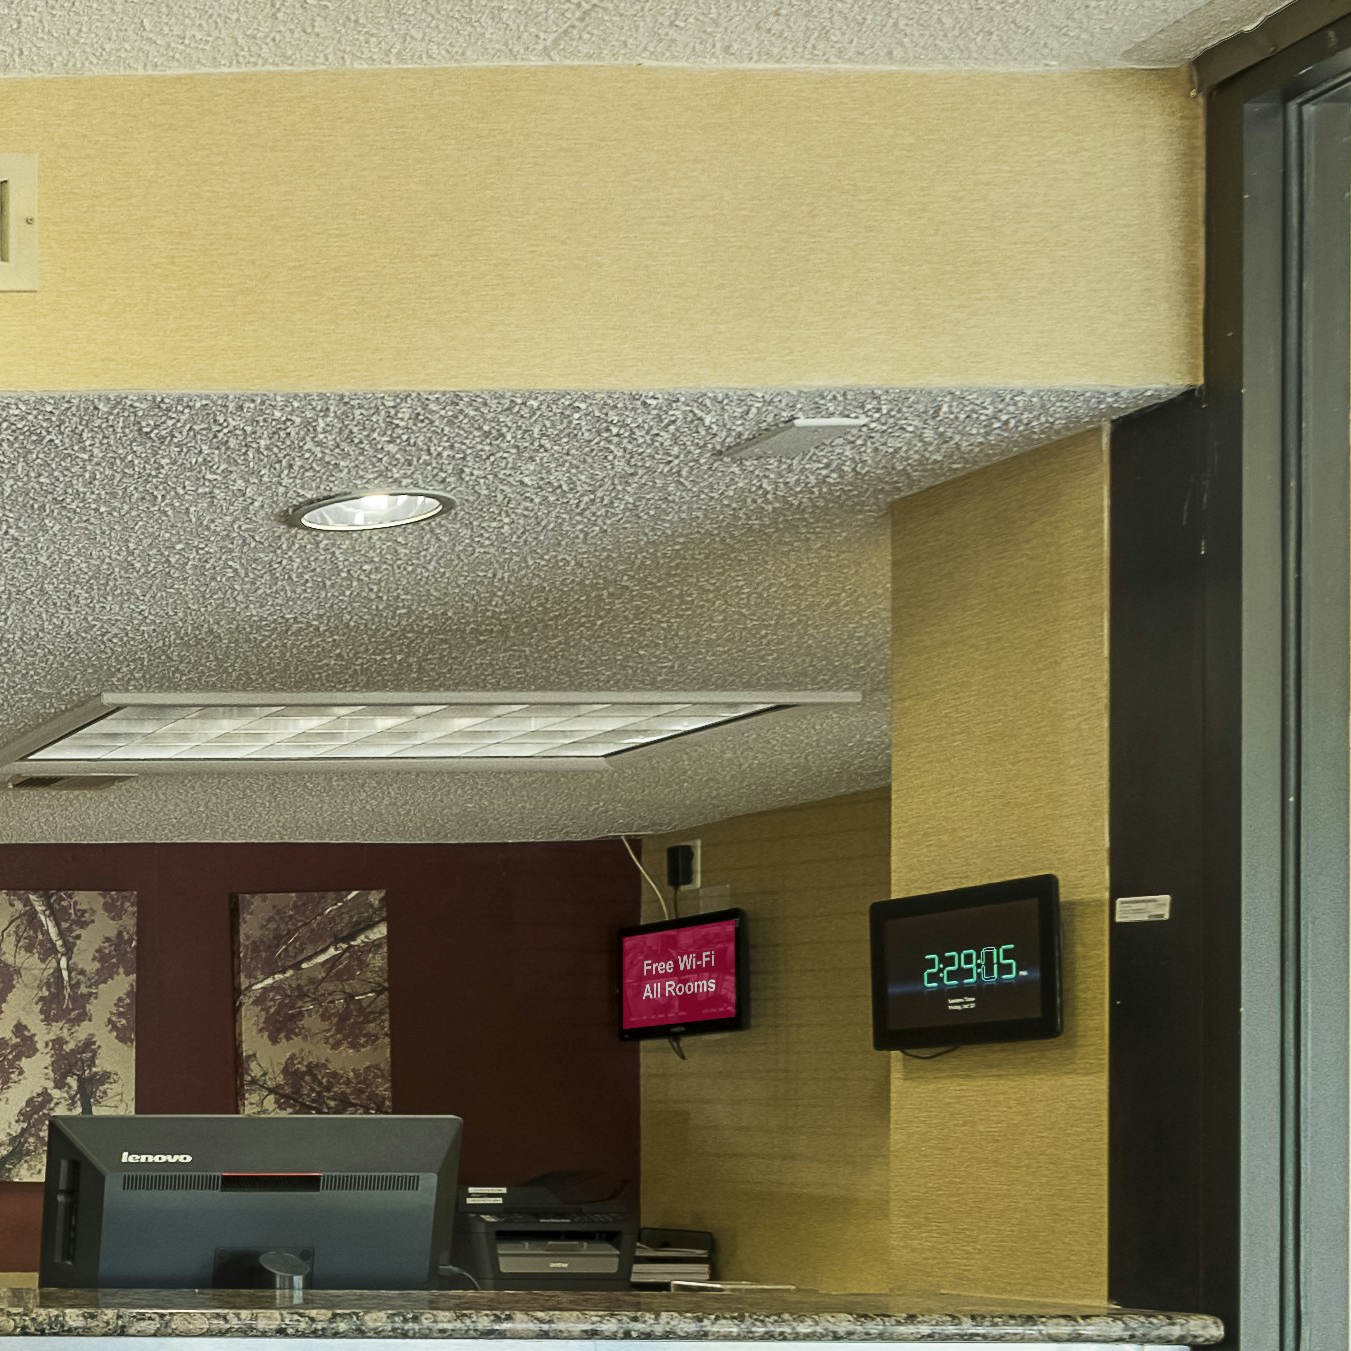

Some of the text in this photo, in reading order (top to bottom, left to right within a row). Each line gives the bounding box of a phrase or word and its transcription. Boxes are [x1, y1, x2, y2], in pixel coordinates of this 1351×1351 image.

[643, 951, 715, 976] Free Wi-Fi
[642, 979, 716, 1000] All Rooms
[121, 1151, 193, 1163] lenovo
